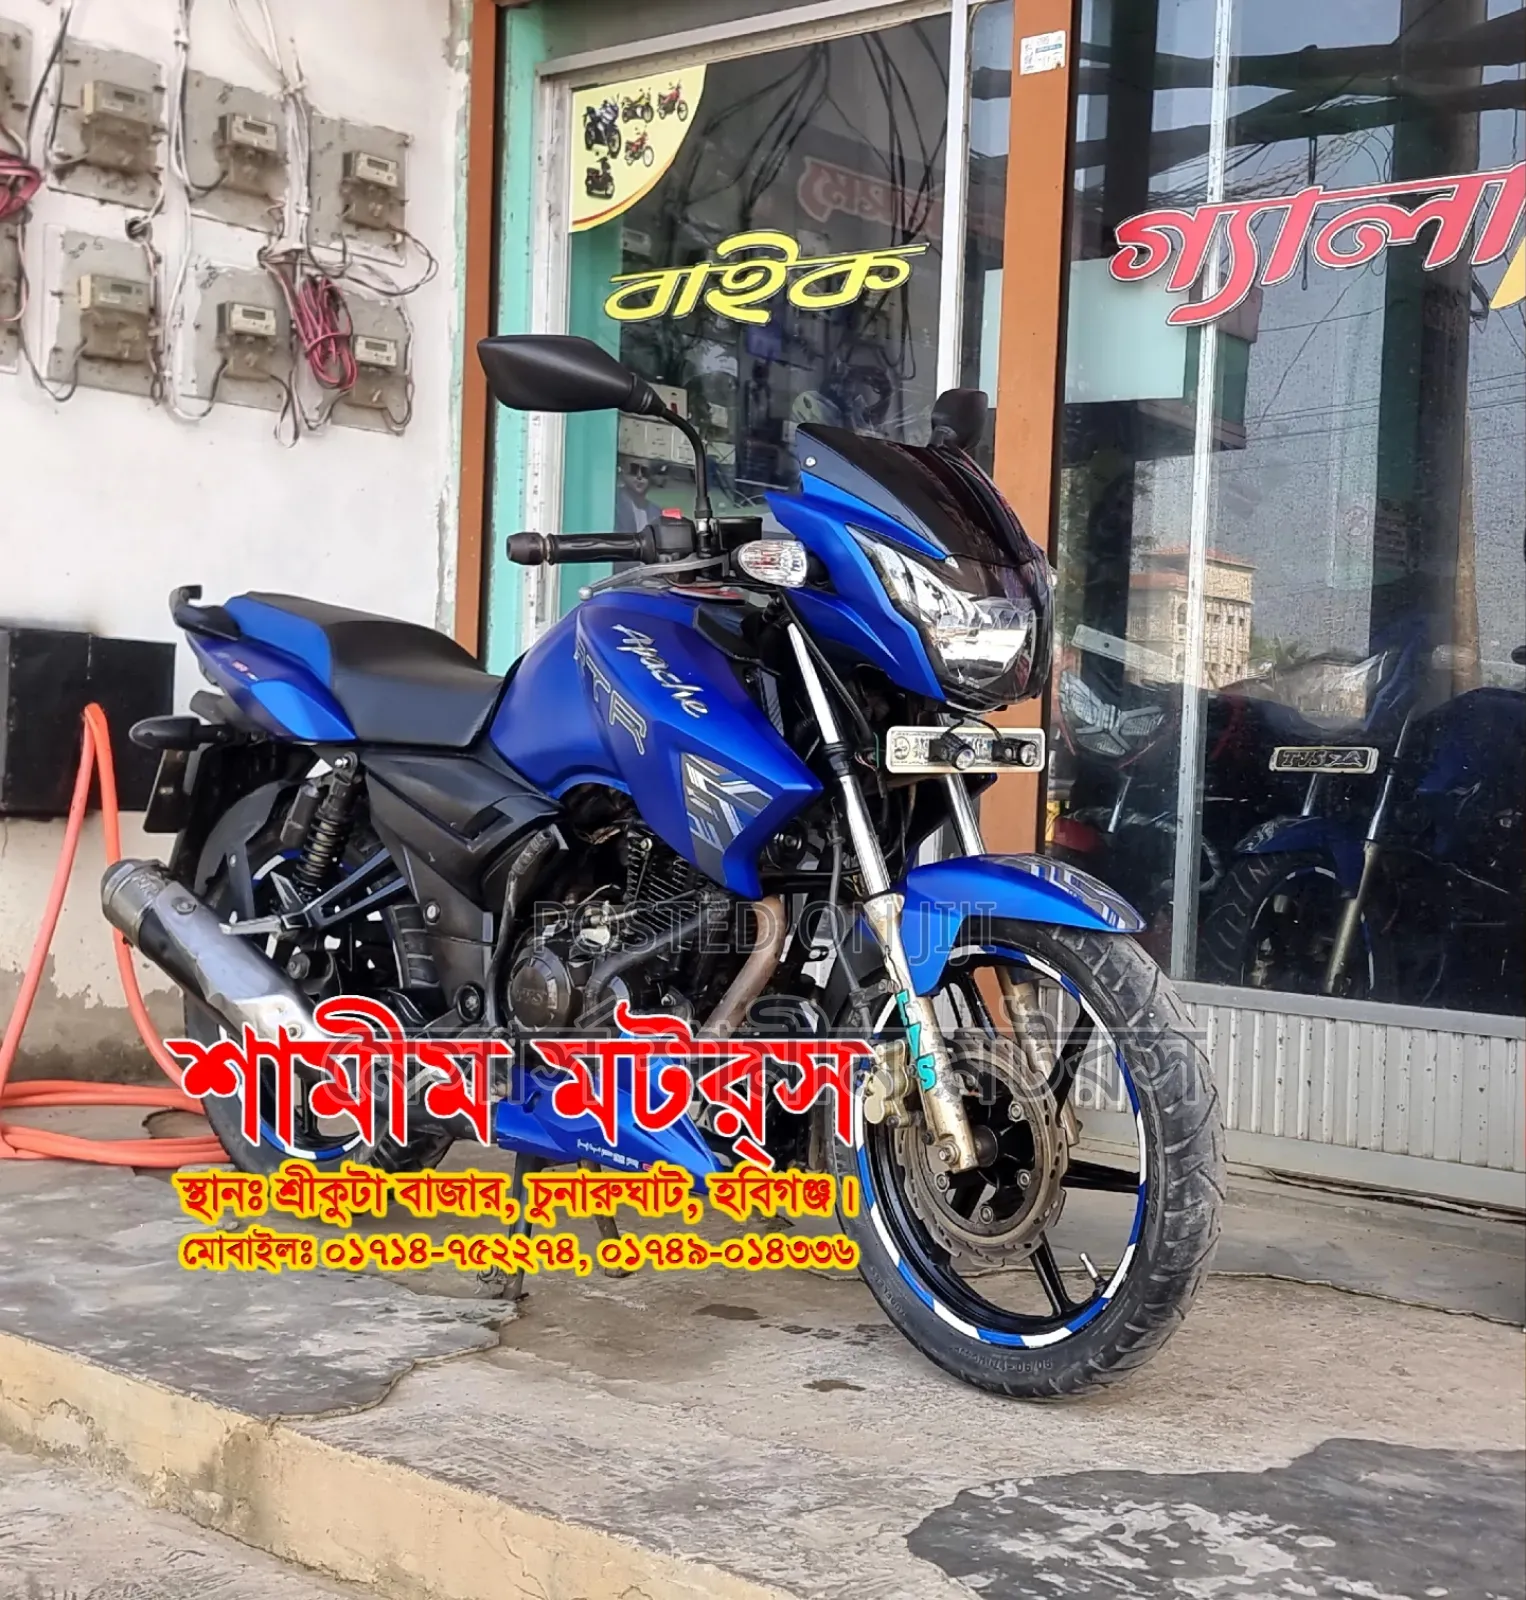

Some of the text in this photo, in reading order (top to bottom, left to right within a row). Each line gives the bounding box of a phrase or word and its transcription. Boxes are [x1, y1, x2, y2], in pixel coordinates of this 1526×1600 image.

[603, 229, 931, 326] বাইক
[611, 623, 709, 719] Apache
[1281, 749, 1328, 767] TVS
